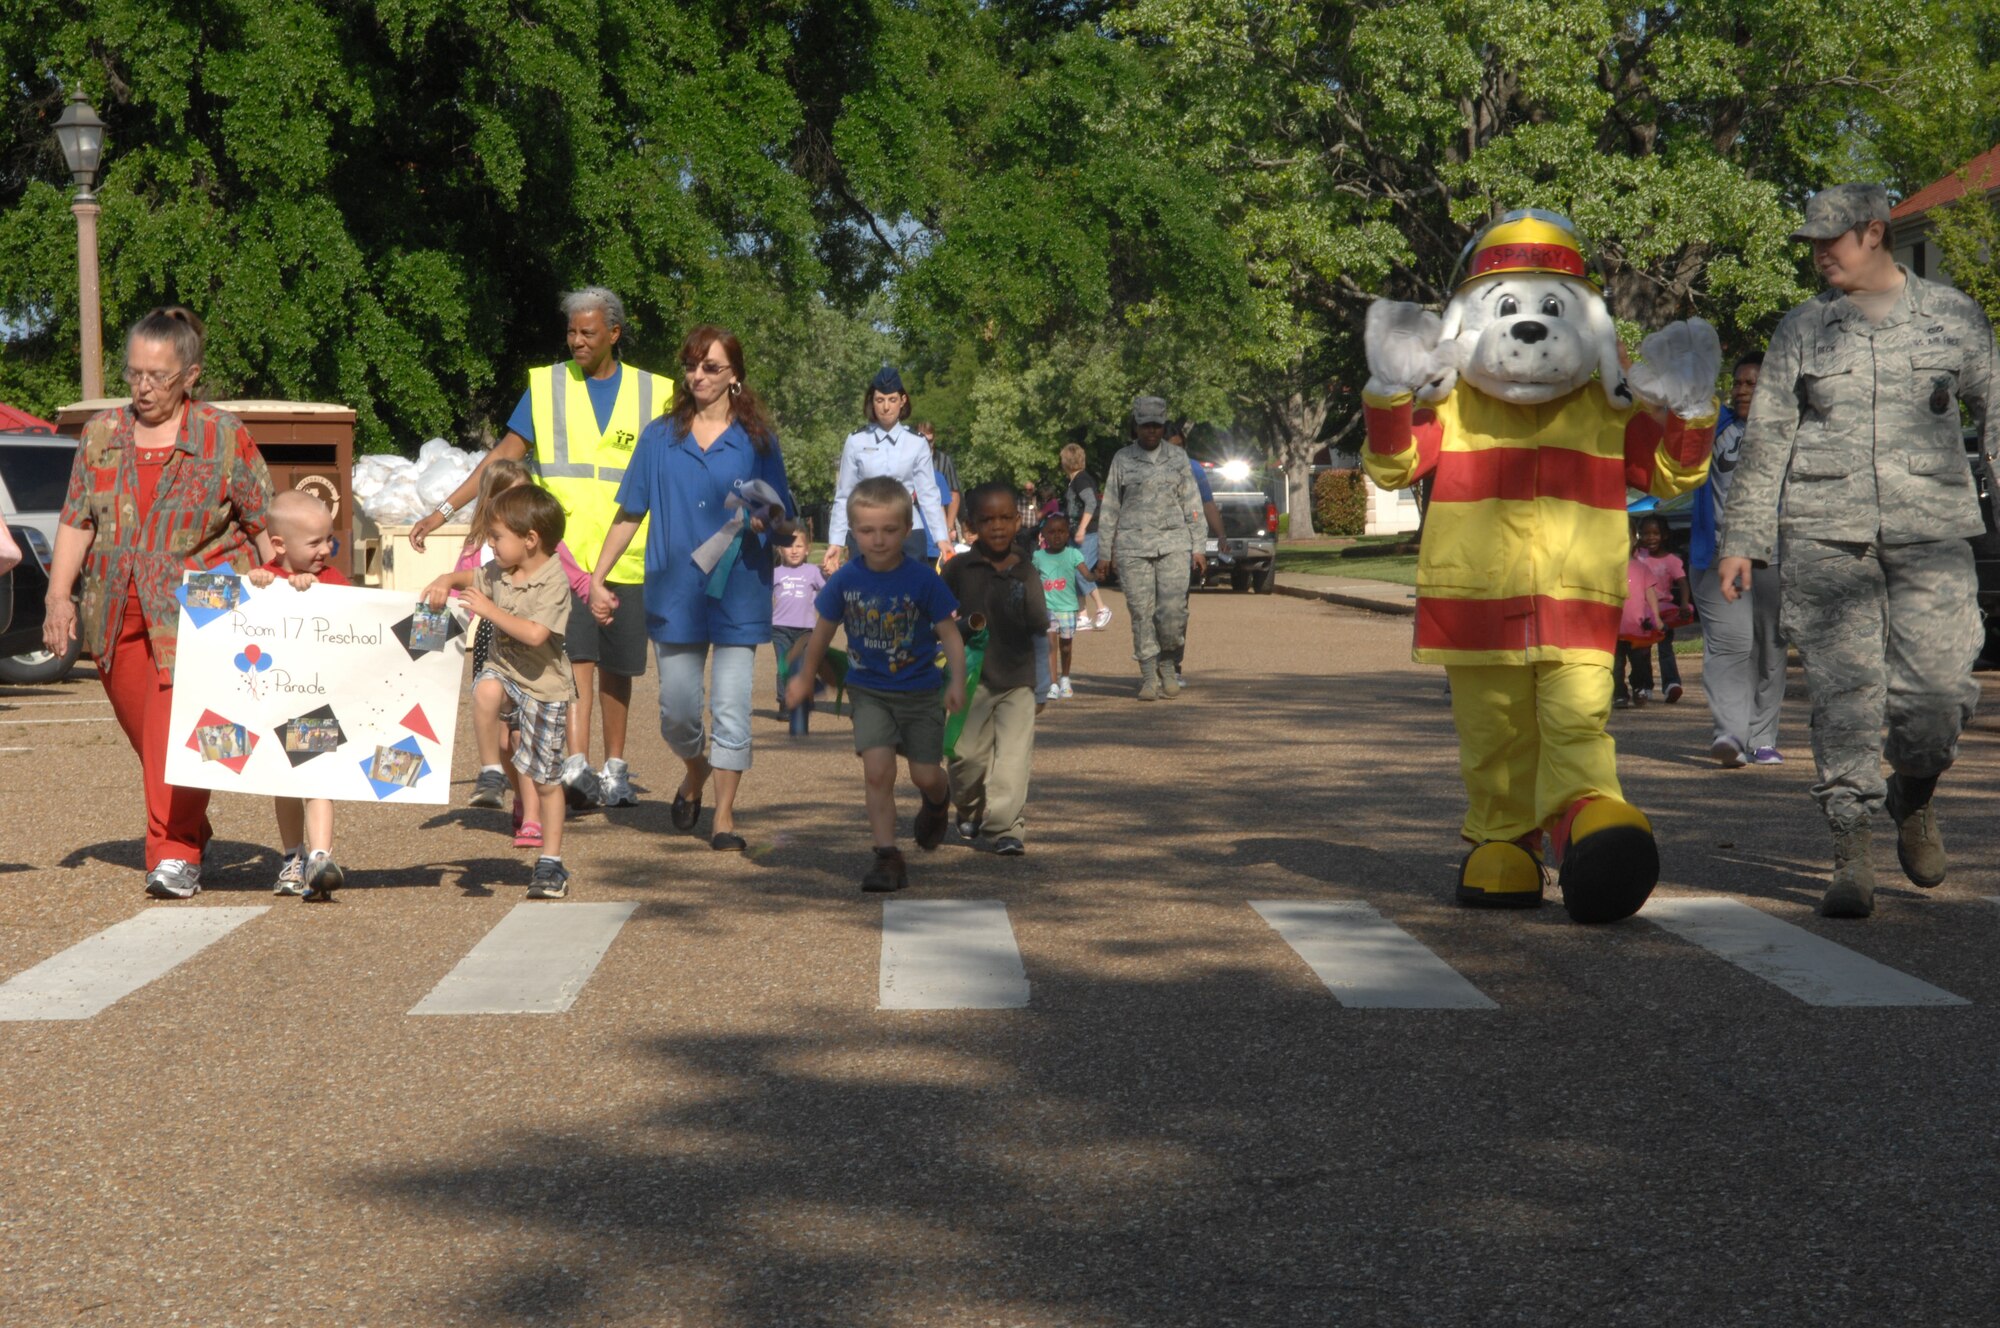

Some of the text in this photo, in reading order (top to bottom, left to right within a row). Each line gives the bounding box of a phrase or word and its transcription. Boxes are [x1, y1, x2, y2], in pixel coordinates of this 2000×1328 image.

[1493, 247, 1563, 263] SPARKY
[229, 609, 383, 646] Room 17 Preschool
[863, 637, 887, 649] WORLD
[269, 668, 327, 696] Parade
